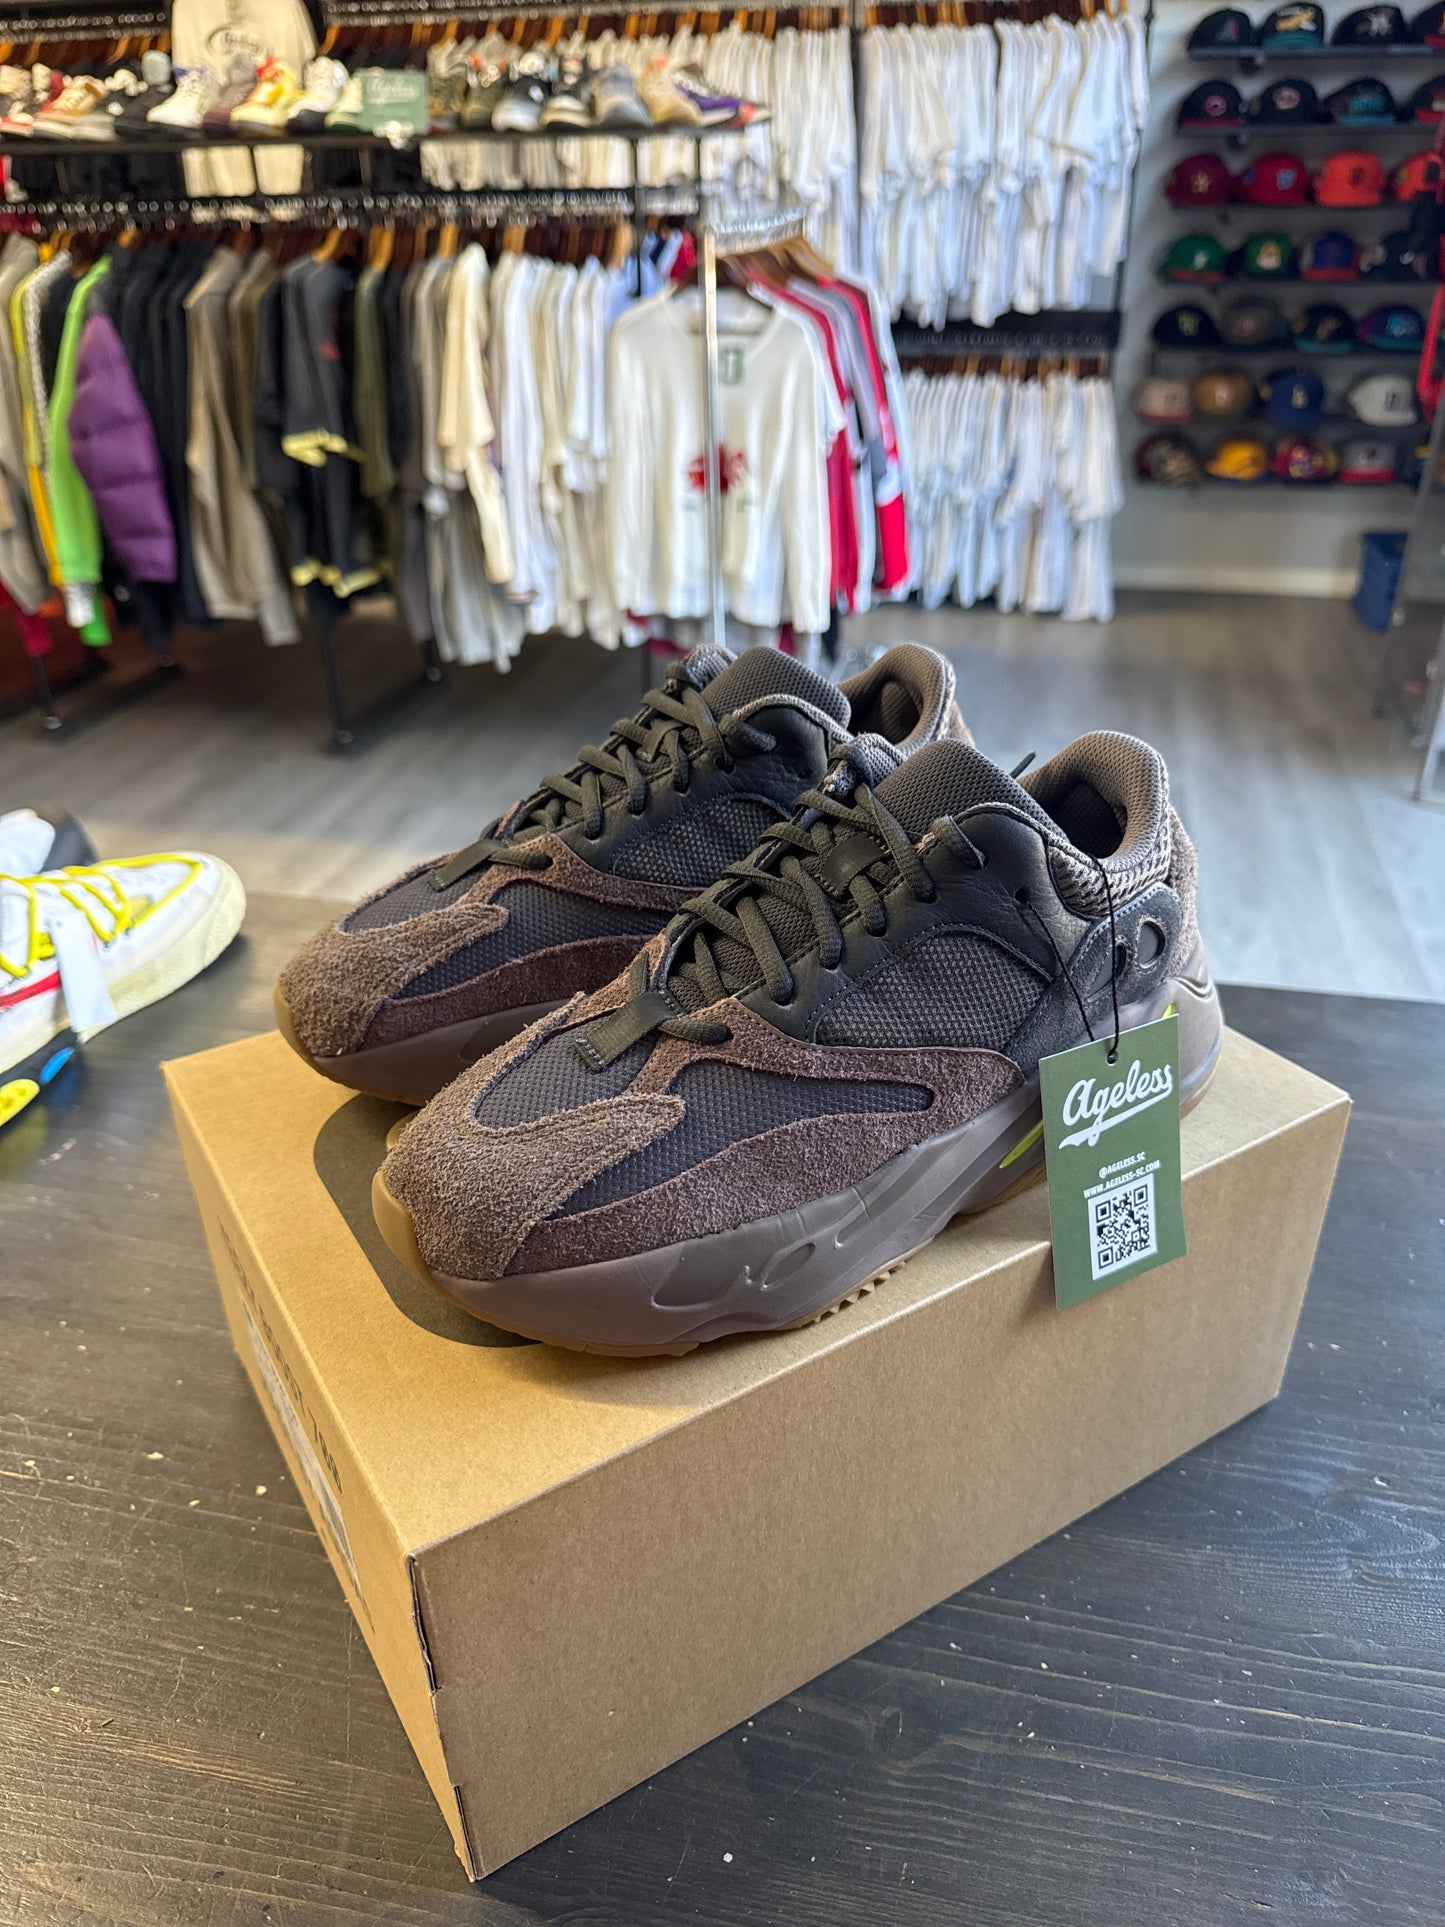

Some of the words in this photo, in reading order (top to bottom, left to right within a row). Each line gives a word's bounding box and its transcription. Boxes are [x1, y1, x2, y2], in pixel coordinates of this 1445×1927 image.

[1062, 1060, 1172, 1147] Ageless
[1083, 1160, 1160, 1198] WWW.AGELESS-SC.COM
[1099, 1151, 1146, 1179] @AGELESS.SC
